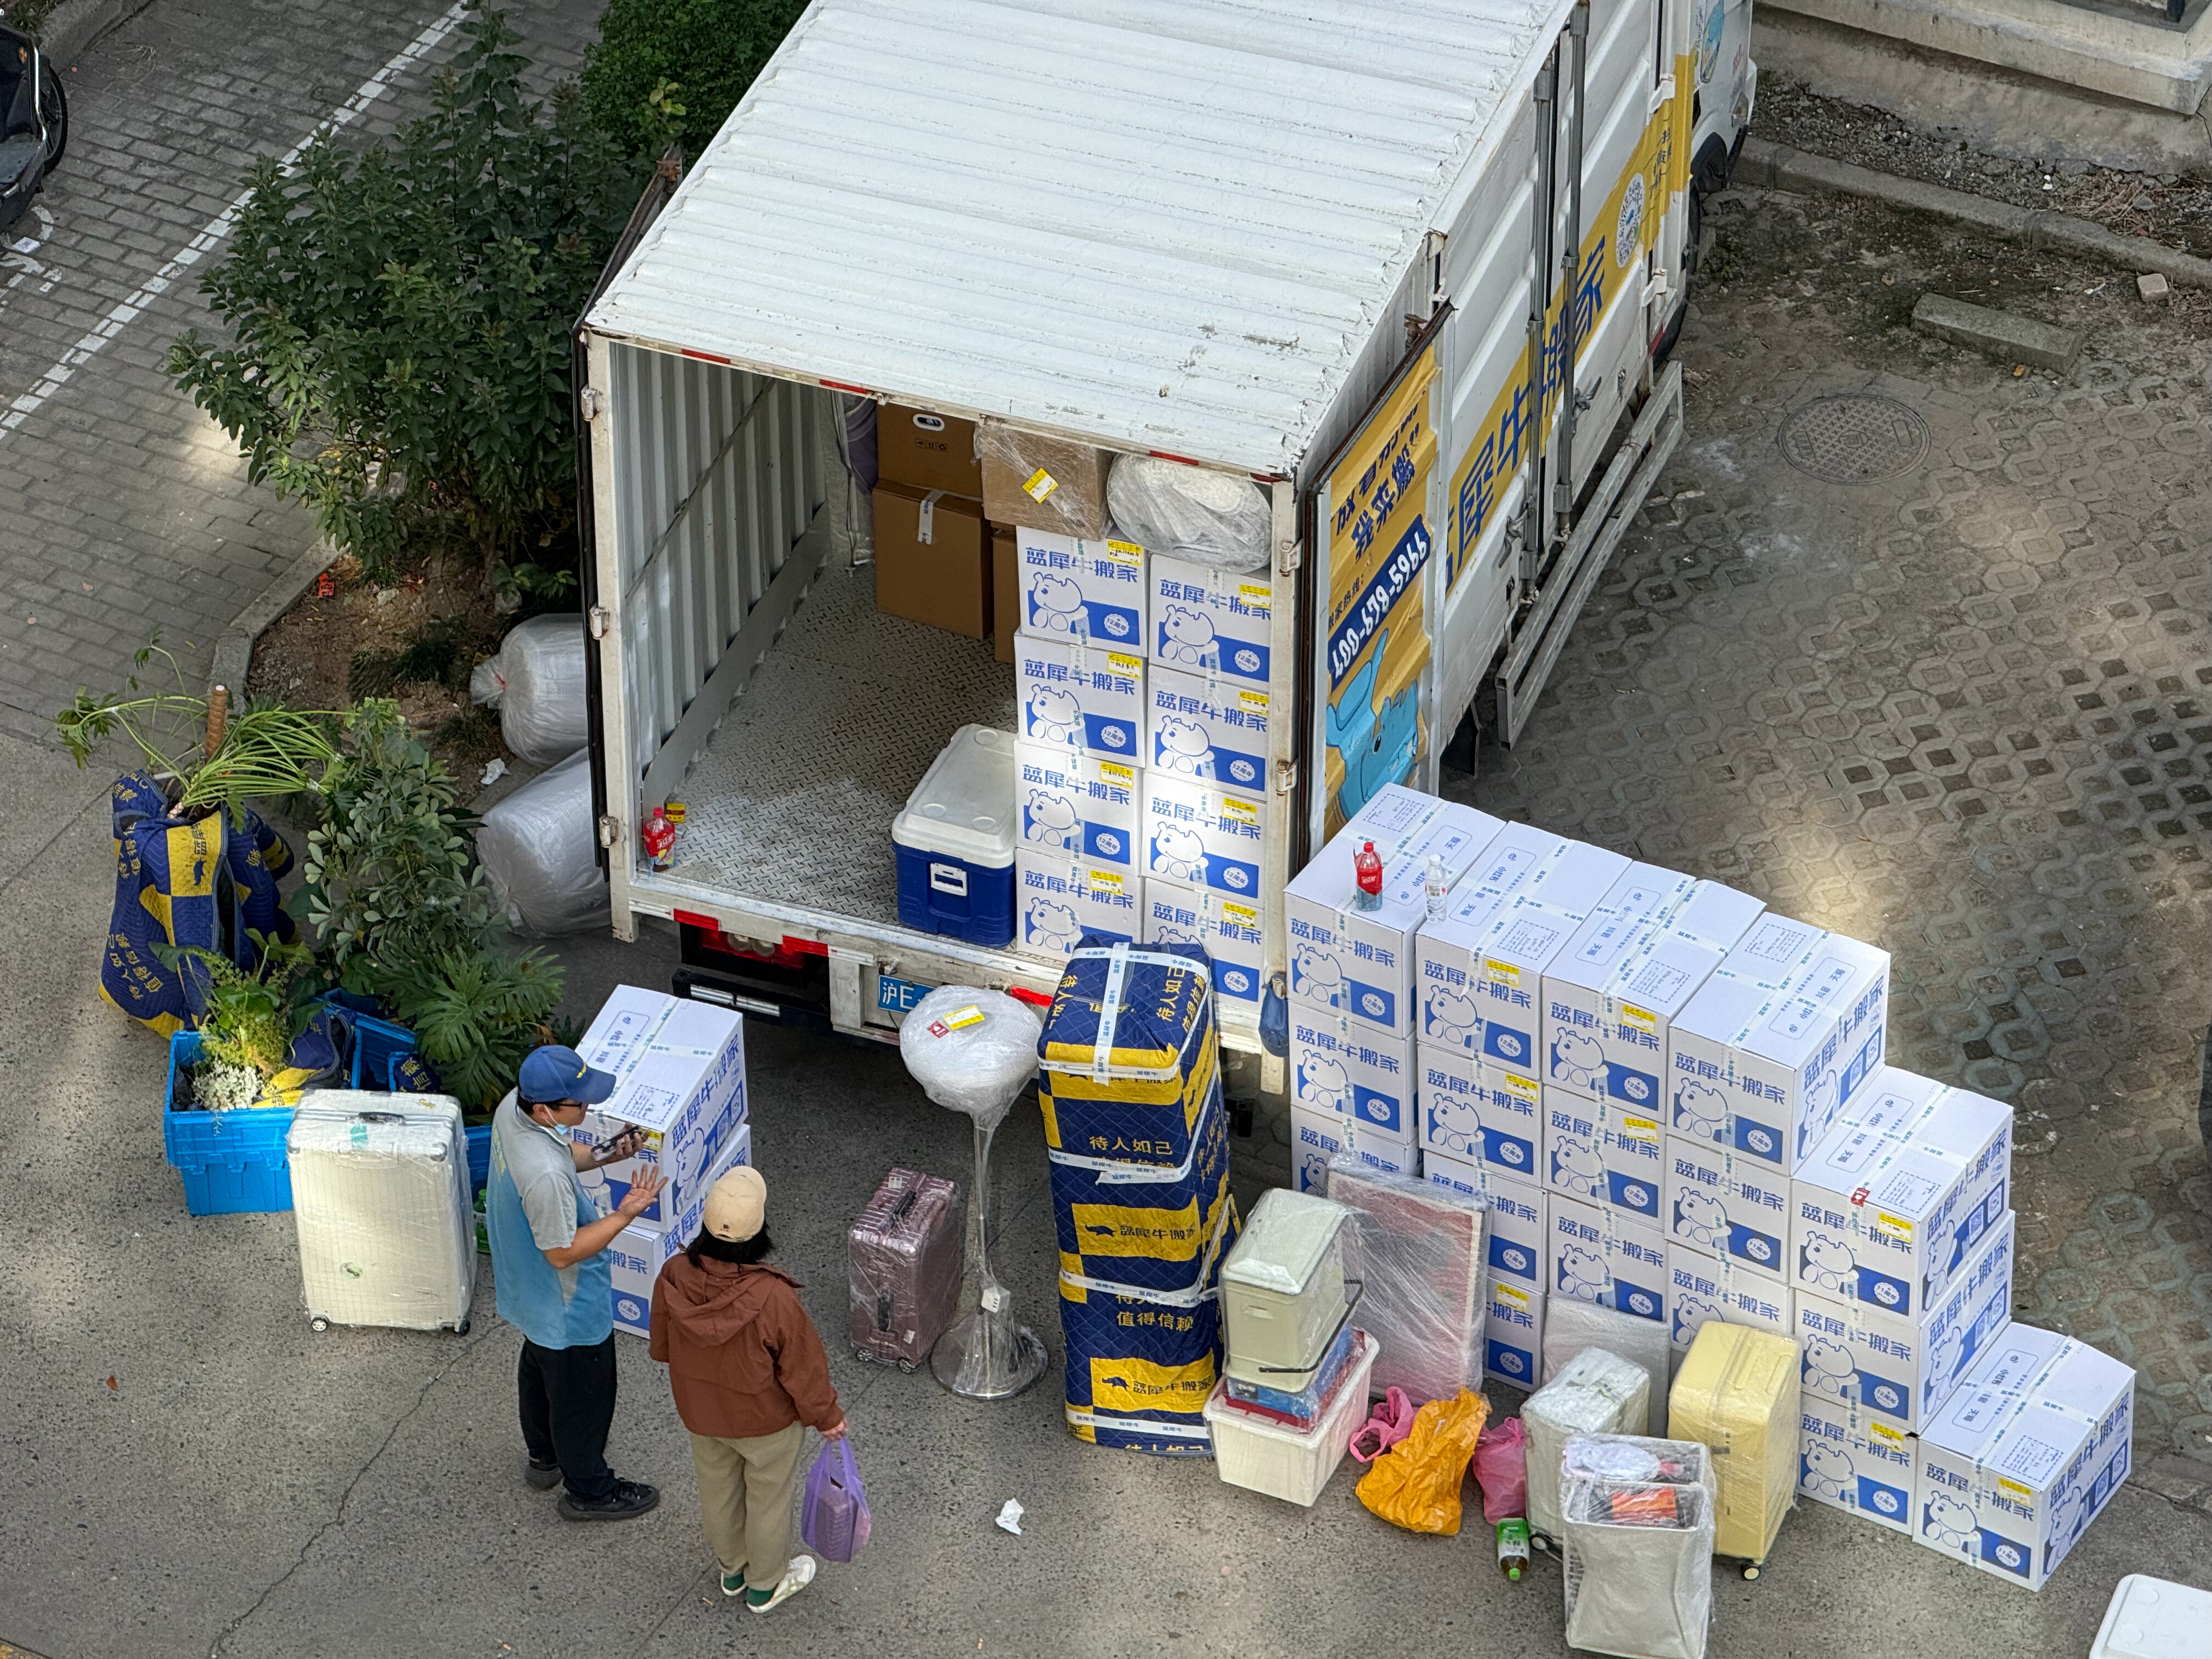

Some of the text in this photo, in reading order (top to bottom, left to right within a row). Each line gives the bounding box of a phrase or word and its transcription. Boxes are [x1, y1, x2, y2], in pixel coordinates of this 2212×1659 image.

[1446, 234, 1605, 593] 犀牛搬家
[1025, 547, 1138, 583] 蓝犀牛搬家
[1159, 579, 1271, 620] 蓝犀牛搬家
[1332, 531, 1427, 679] 400-678-5966
[1107, 617, 1128, 632] 12周年
[1024, 658, 1136, 696] 蓝犀牛搬家
[1237, 652, 1259, 668] 12周年
[1156, 690, 1267, 732] 蓝犀牛搬家
[1104, 729, 1125, 743] 12周年
[1022, 764, 1130, 806] 蓝犀牛搬家
[1232, 762, 1254, 777] 12周年
[1152, 796, 1261, 840] 蓝犀牛搬家
[1098, 837, 1120, 850] 12周年
[1444, 836, 1462, 850] 天猫
[1024, 870, 1134, 909] 蓝犀牛搬家
[1226, 870, 1248, 883] 12周年
[1488, 866, 1507, 882] 小红书
[1153, 901, 1261, 945] 蓝犀牛搬家
[1460, 903, 1476, 917] 天猫
[1290, 917, 1395, 968] 蓝犀牛搬家
[1586, 943, 1602, 956] 天猫
[1600, 926, 1617, 939] 抖音
[109, 934, 144, 1000] 待人如己
[118, 932, 165, 993] 值得信赖
[1226, 974, 1248, 988] 12周年
[1829, 968, 1846, 983] 天猫
[1156, 966, 1186, 1022] 待人如己
[1364, 997, 1385, 1012] 12周年
[1815, 985, 1831, 1000] 抖音
[1550, 1001, 1660, 1052] 蓝犀牛搬家
[1799, 1006, 1814, 1020] 小红
[1296, 1024, 1400, 1074] 蓝犀牛搬家
[1500, 1040, 1520, 1054] 12周年
[1803, 975, 1883, 1091] 蓝犀牛搬家
[673, 1034, 739, 1150] 蓝犀牛搬家
[1427, 1068, 1534, 1118] 蓝犀牛搬家
[1675, 1052, 1786, 1105] 蓝犀牛搬家
[1370, 1102, 1388, 1118] 12周年
[1089, 1136, 1173, 1156] 待人如己
[1300, 1127, 1399, 1172] 蓝犀搬家
[1503, 1146, 1521, 1160] 12周年
[1550, 1110, 1660, 1160] 蓝犀牛搬家
[1750, 1135, 1770, 1148] 12周年
[1851, 1132, 1867, 1146] 抖音
[1837, 1149, 1853, 1164] 天猫
[1627, 1188, 1646, 1203] 12周年
[1675, 1159, 1784, 1212] 蓝犀牛搬家
[1927, 1128, 2007, 1242] 蓝犀牛搬家
[1119, 1222, 1195, 1241] 蓝犀牛搬家
[1558, 1216, 1663, 1268] 蓝犀牛搬家
[1801, 1203, 1912, 1254] 蓝犀牛搬家
[1673, 1268, 1780, 1322] 蓝犀牛搬家
[1929, 1232, 2009, 1348] 蓝犀牛搬家
[1117, 1311, 1194, 1332] 值得信赖
[1486, 1301, 1534, 1329] 搬家
[1803, 1308, 1911, 1362] 蓝犀牛搬家
[1132, 1375, 1214, 1396] 蓝犀牛搬家
[1991, 1368, 2009, 1386] 小红书
[1962, 1407, 1980, 1423] 天猫
[1802, 1414, 1911, 1468] 蓝犀牛搬家
[2050, 1392, 2129, 1509] 蓝犀牛搬家
[1926, 1462, 2035, 1522] 蓝犀牛搬家
